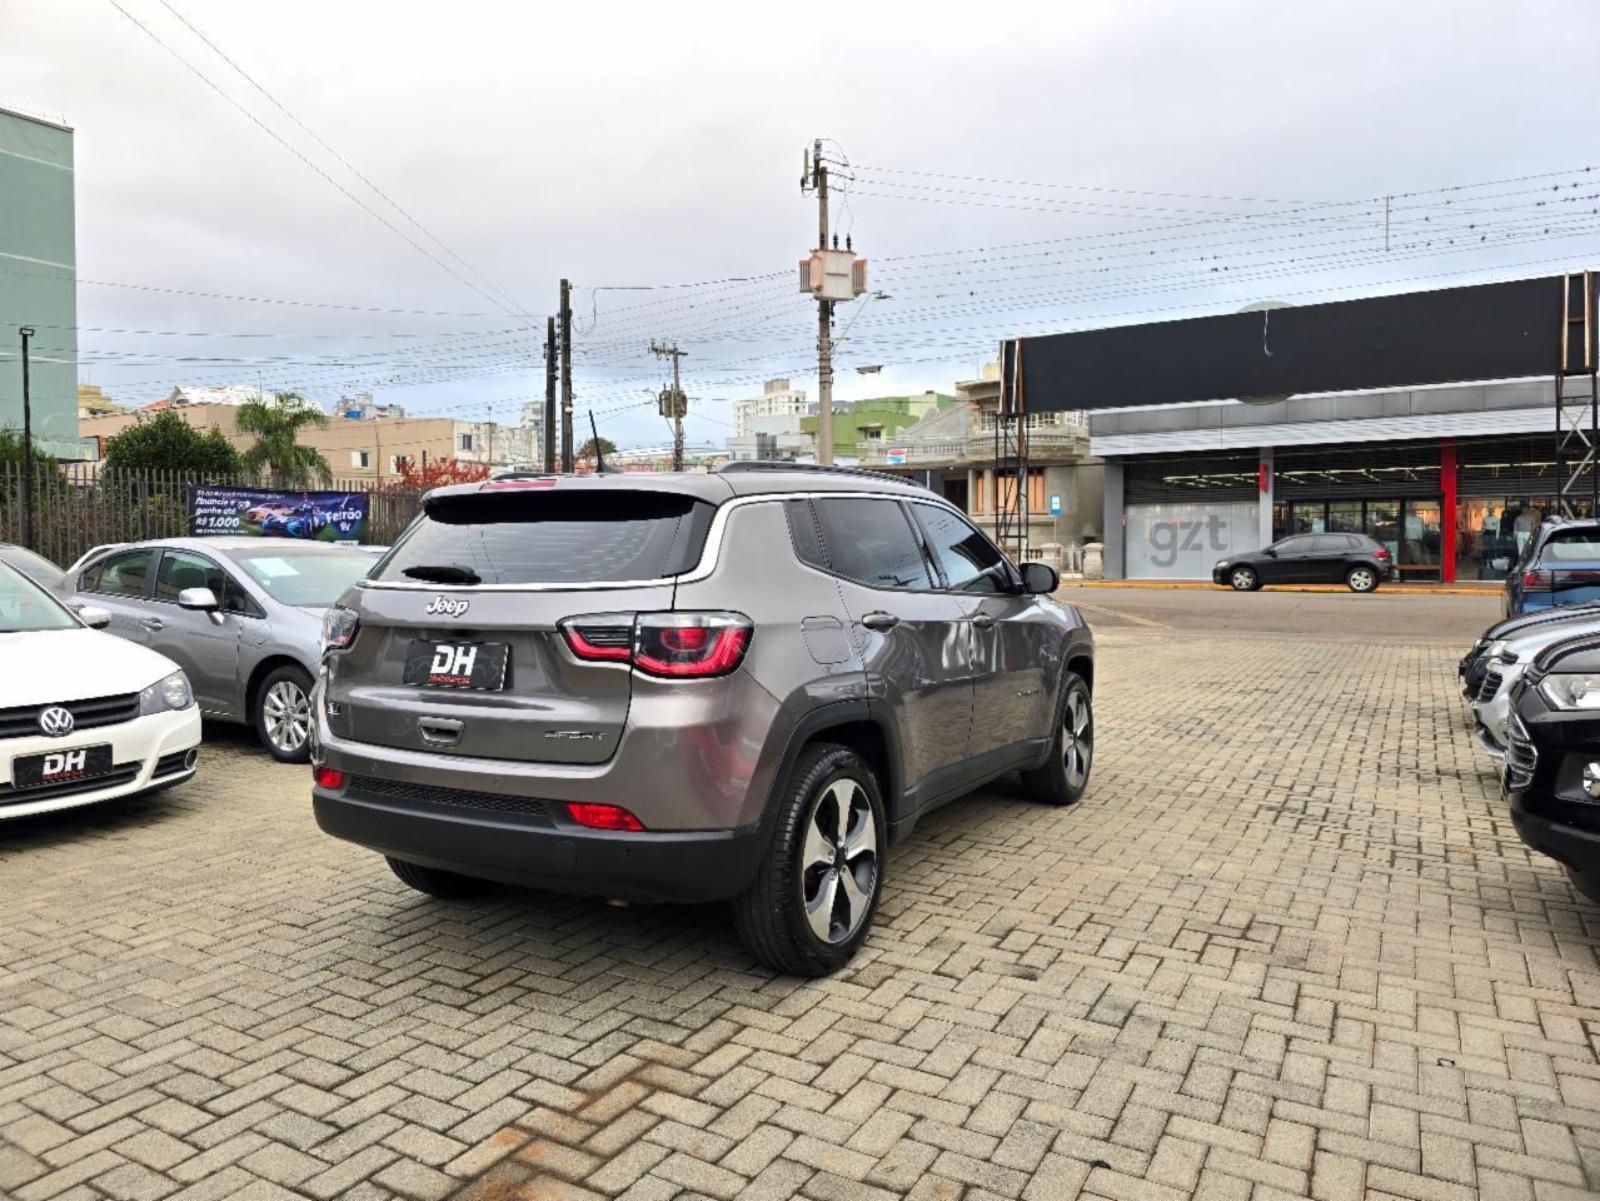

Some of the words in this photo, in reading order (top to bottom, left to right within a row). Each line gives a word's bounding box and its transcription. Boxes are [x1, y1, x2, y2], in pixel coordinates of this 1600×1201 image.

[195, 517, 208, 526] R$
[208, 517, 240, 527] 1.000
[325, 507, 363, 523] Feirão
[1149, 515, 1228, 568] gzt
[425, 595, 469, 618] Jeep
[430, 645, 477, 676] DH
[42, 750, 87, 775] DH
